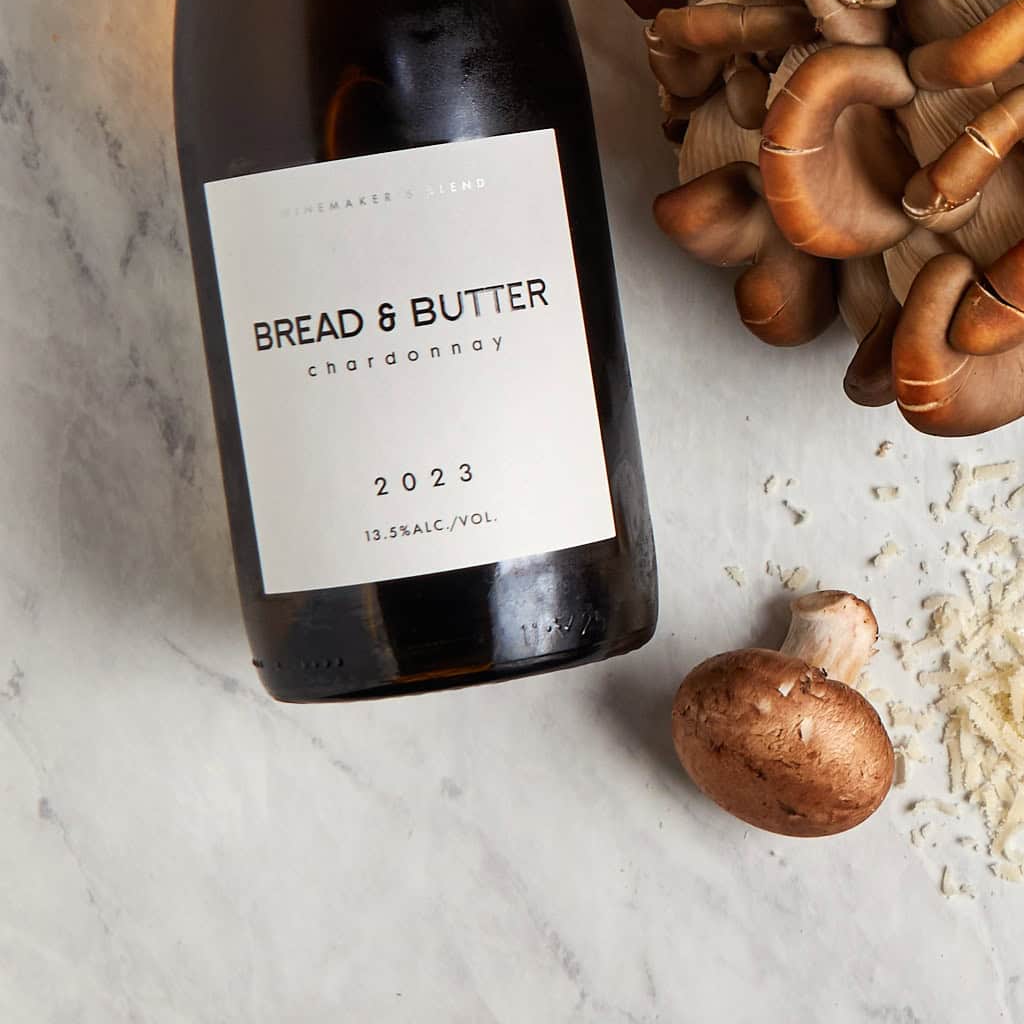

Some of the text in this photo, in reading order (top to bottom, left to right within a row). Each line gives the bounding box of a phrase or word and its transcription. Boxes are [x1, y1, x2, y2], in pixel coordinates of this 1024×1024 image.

[424, 177, 486, 199] LEND
[253, 278, 549, 352] BREAD & BUTTER
[307, 335, 503, 377] chardonnay
[374, 463, 473, 496] 2023
